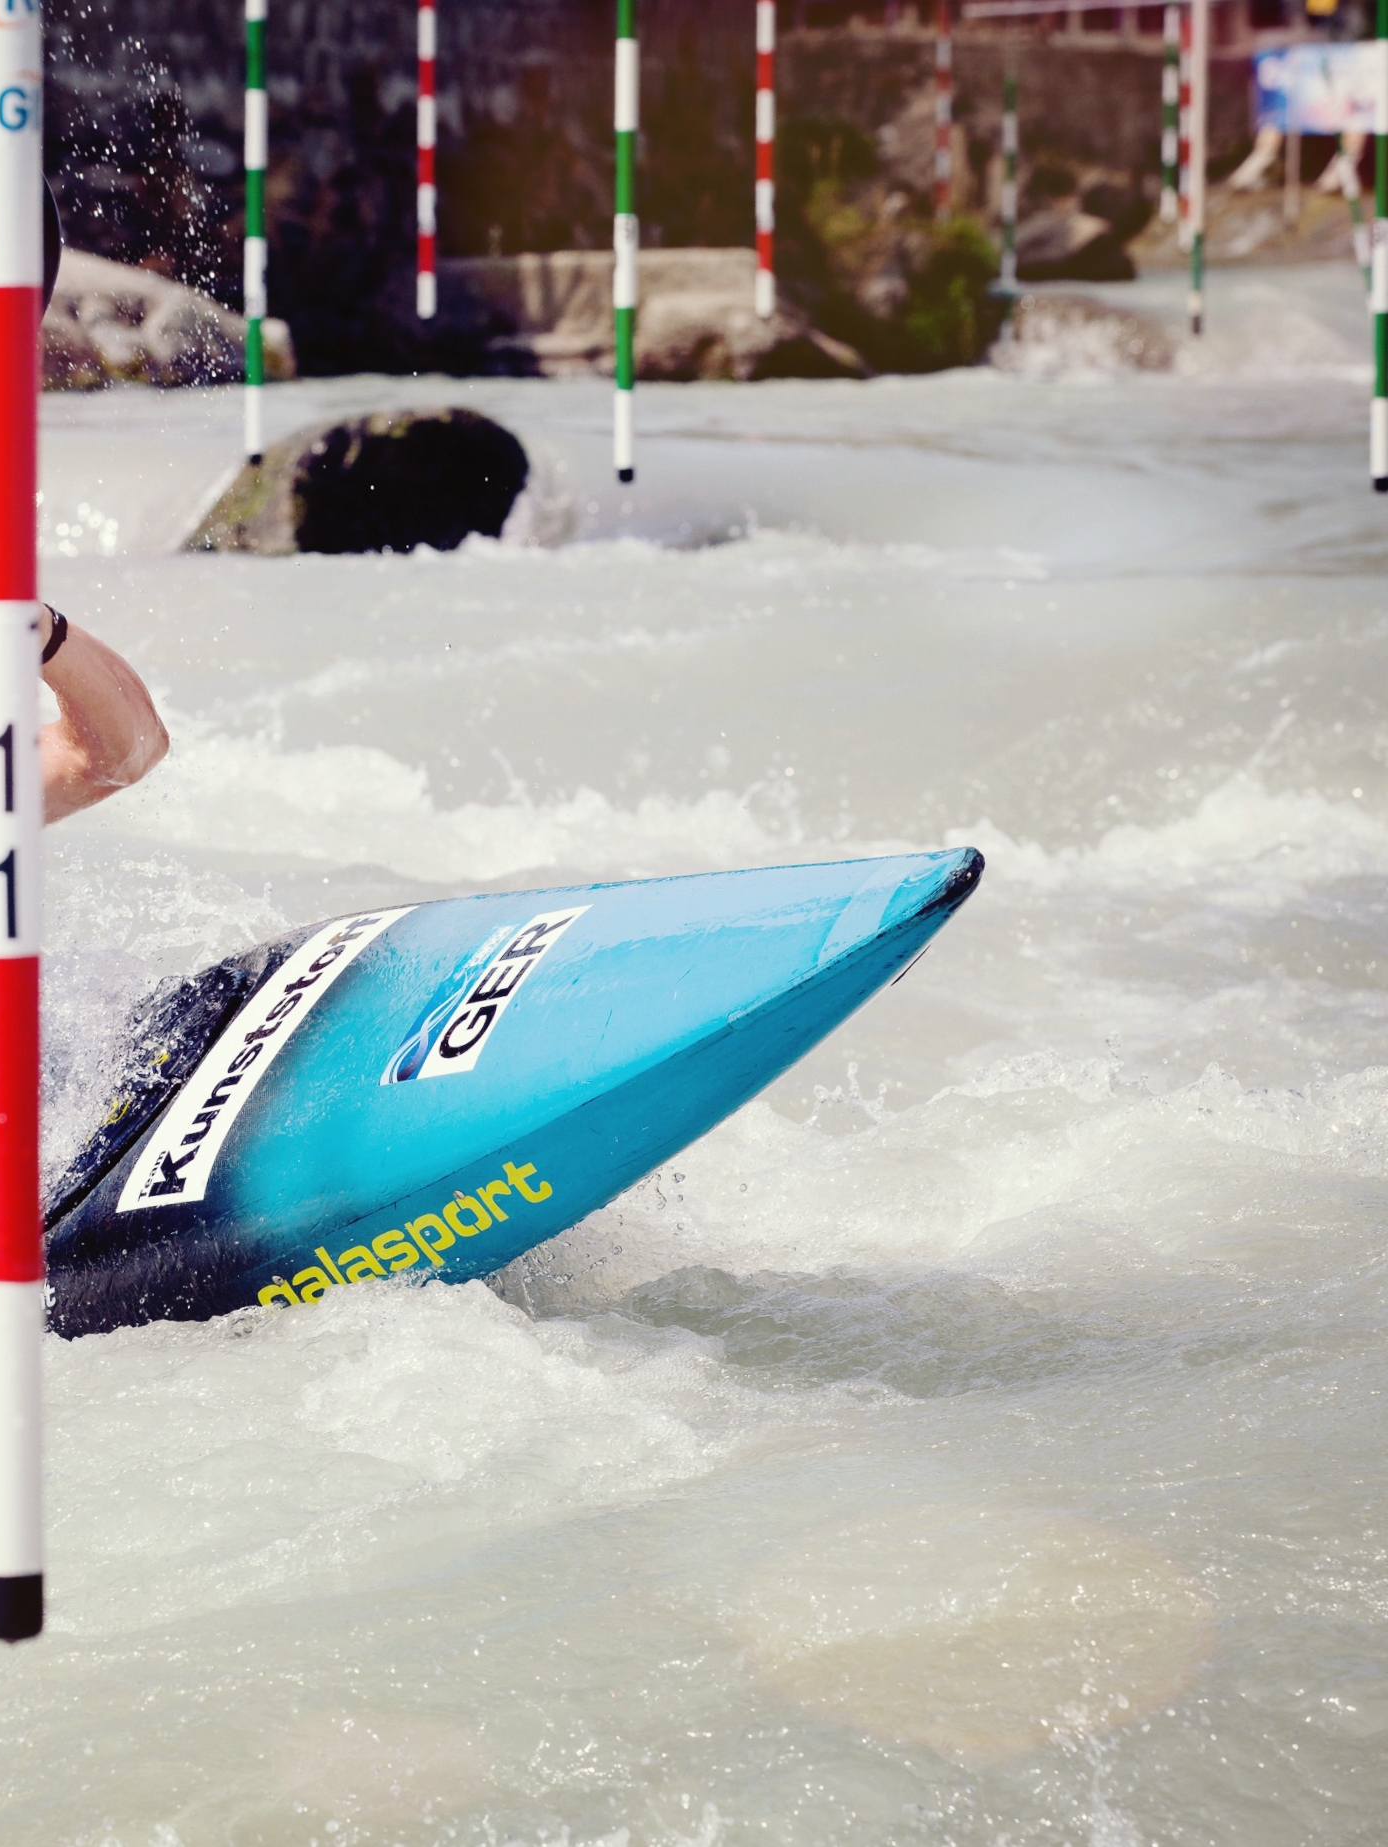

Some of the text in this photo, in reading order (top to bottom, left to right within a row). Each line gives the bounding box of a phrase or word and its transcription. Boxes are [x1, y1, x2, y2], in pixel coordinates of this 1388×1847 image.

[148, 915, 383, 1198] Kunststoff
[439, 914, 575, 1059] GER
[138, 1150, 167, 1201] Team
